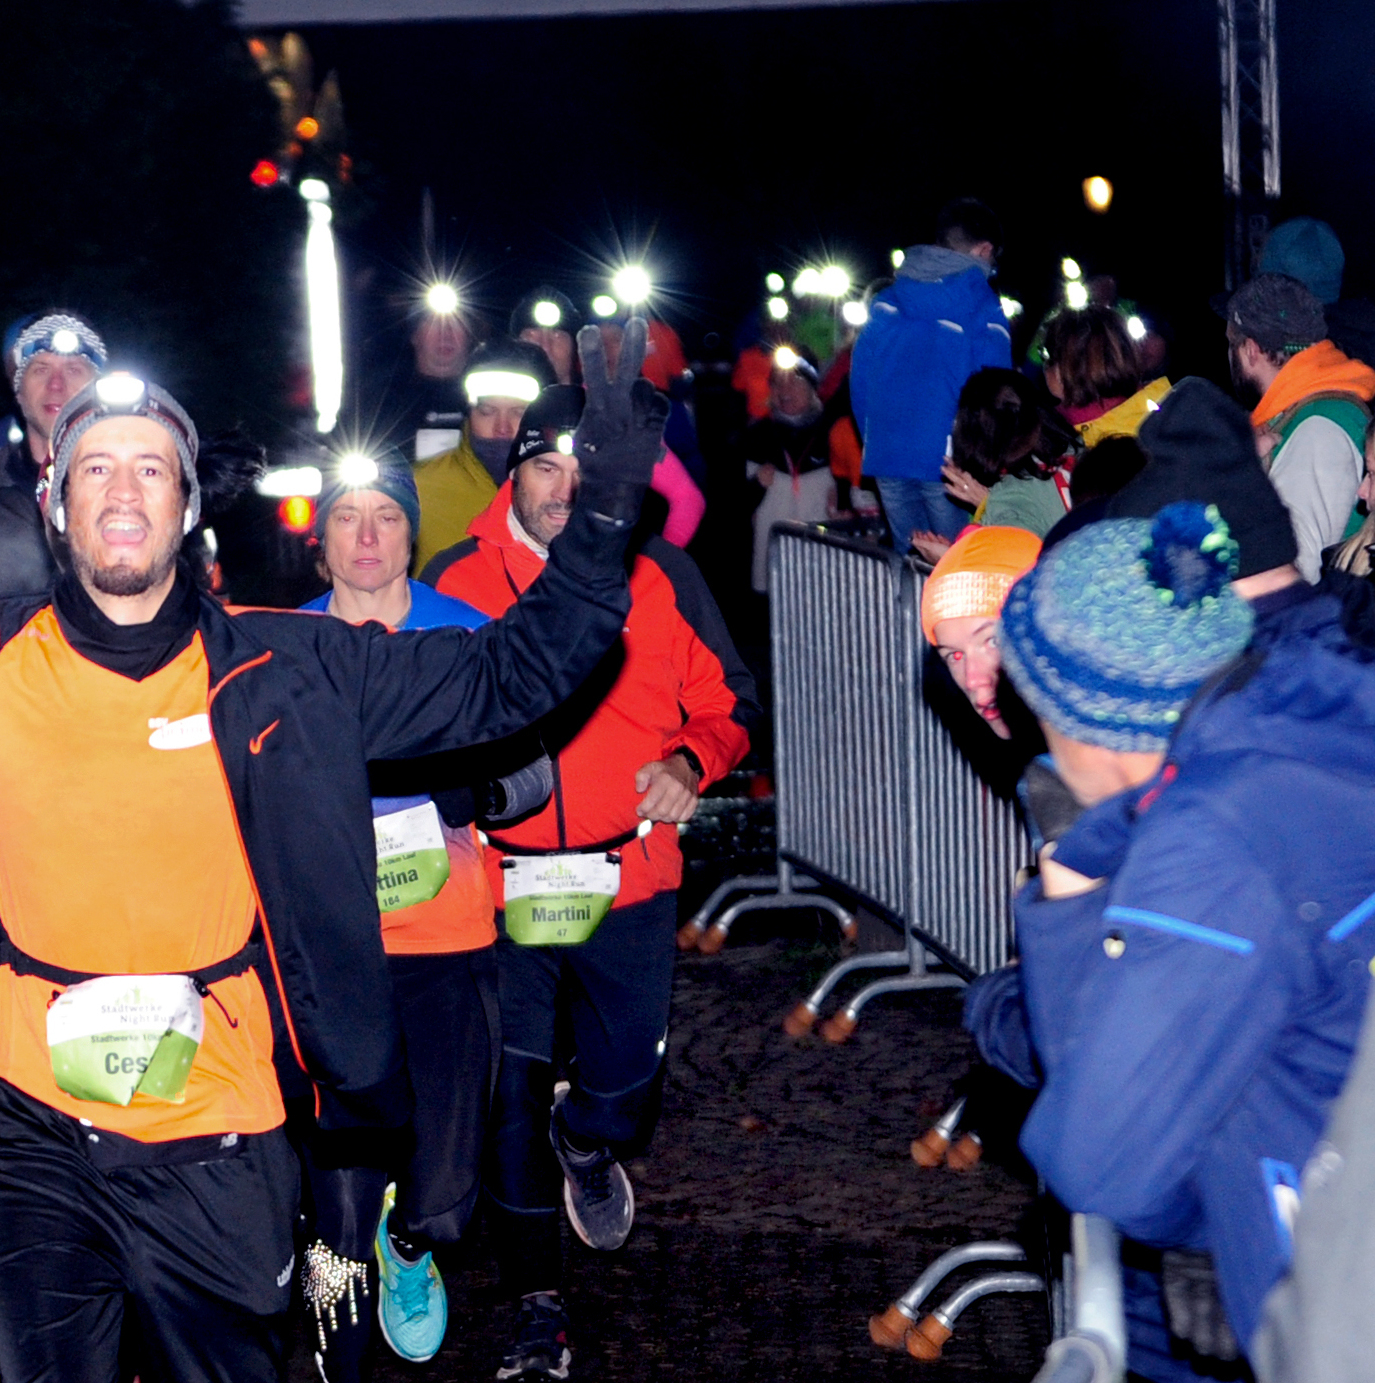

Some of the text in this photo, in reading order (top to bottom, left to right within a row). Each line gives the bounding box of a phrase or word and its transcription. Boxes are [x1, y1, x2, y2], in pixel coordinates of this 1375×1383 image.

[531, 905, 591, 922] Martini
[556, 928, 568, 937] 47
[100, 1004, 163, 1014] Stadtwerke
[91, 1033, 139, 1044] Stadtwerke
